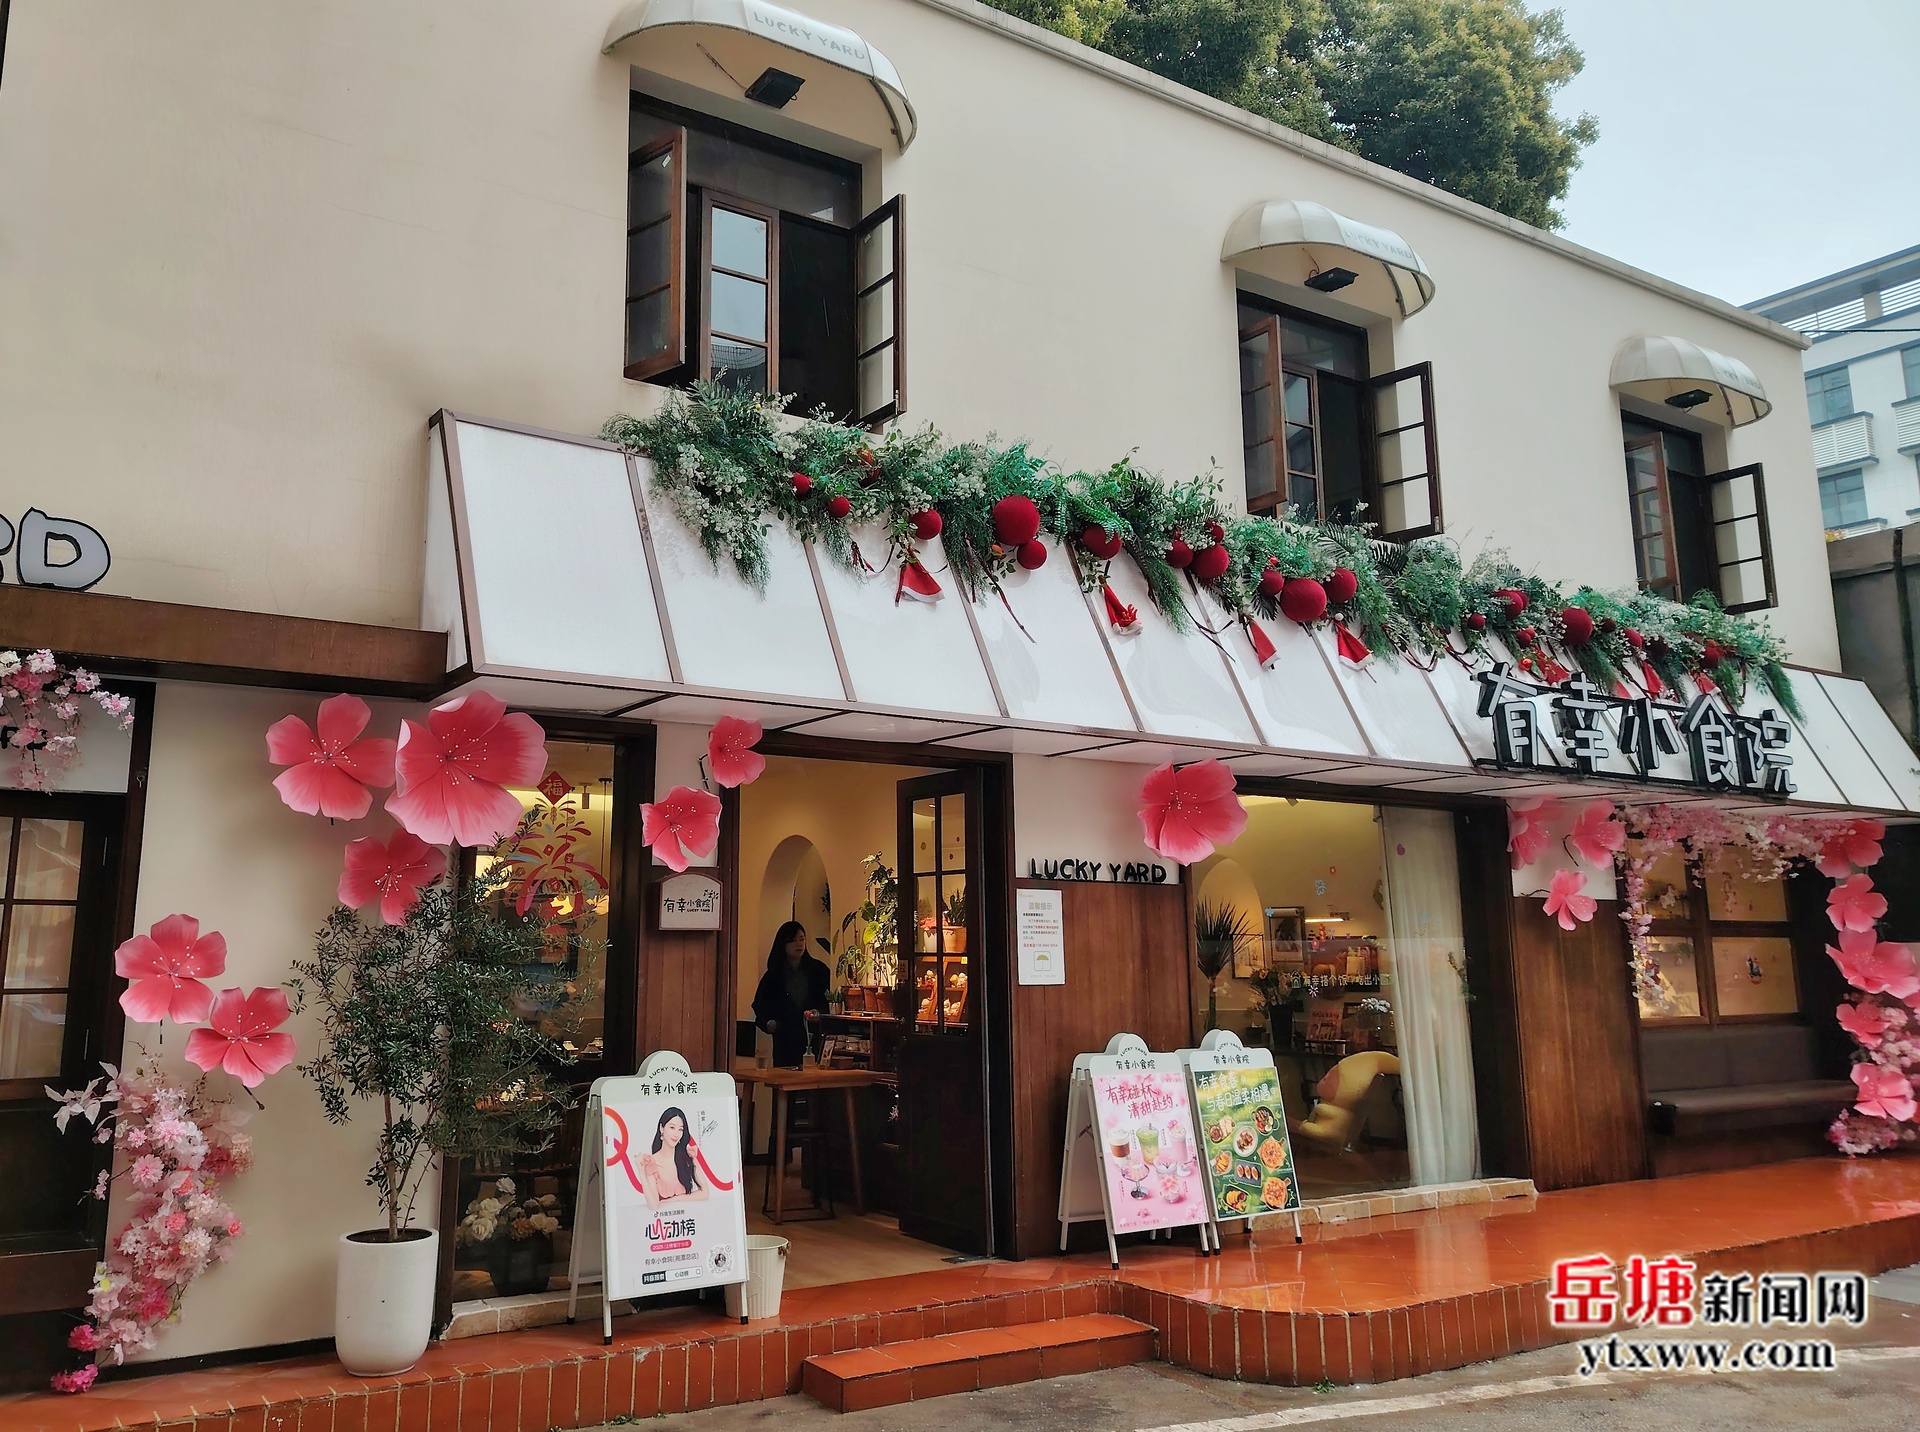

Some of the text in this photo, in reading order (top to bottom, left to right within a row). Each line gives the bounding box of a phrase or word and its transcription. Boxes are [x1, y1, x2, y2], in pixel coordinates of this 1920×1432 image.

[753, 11, 865, 60] LUCKY YARD
[1344, 229, 1412, 259] LUCKY YARD
[0, 507, 111, 591] D
[1470, 662, 1798, 794] 有幸小食院
[543, 778, 564, 796] 福
[1030, 858, 1167, 883] LUCKY YARD
[663, 897, 711, 913] 有幸小食院
[1115, 1059, 1156, 1070] 有幸小食院
[1213, 1054, 1250, 1065] 有幸小食院
[648, 1066, 688, 1080] LUCKY YARD
[640, 1081, 698, 1096] 有幸小食院
[645, 1218, 695, 1240] 心动榜
